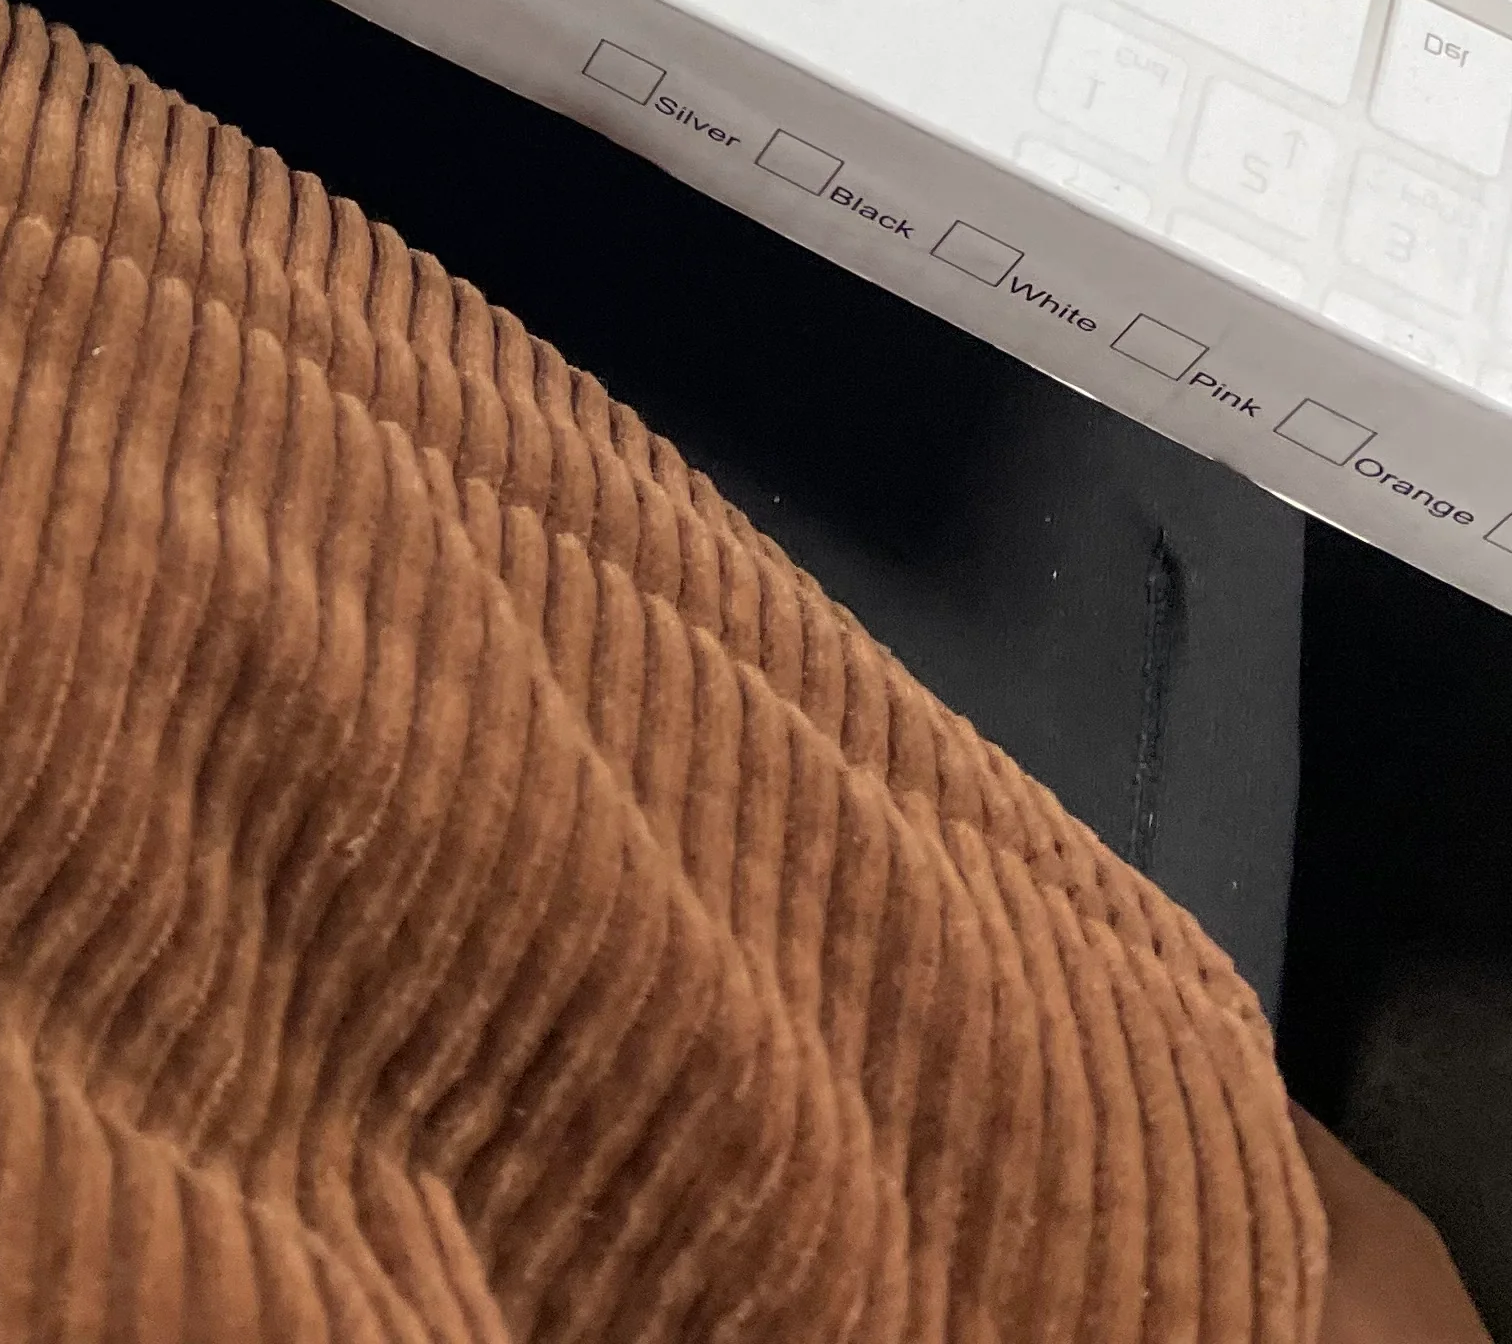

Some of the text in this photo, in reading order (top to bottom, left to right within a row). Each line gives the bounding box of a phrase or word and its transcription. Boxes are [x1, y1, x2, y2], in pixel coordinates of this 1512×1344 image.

[654, 95, 1475, 527] Silver Black White Pink Orange
